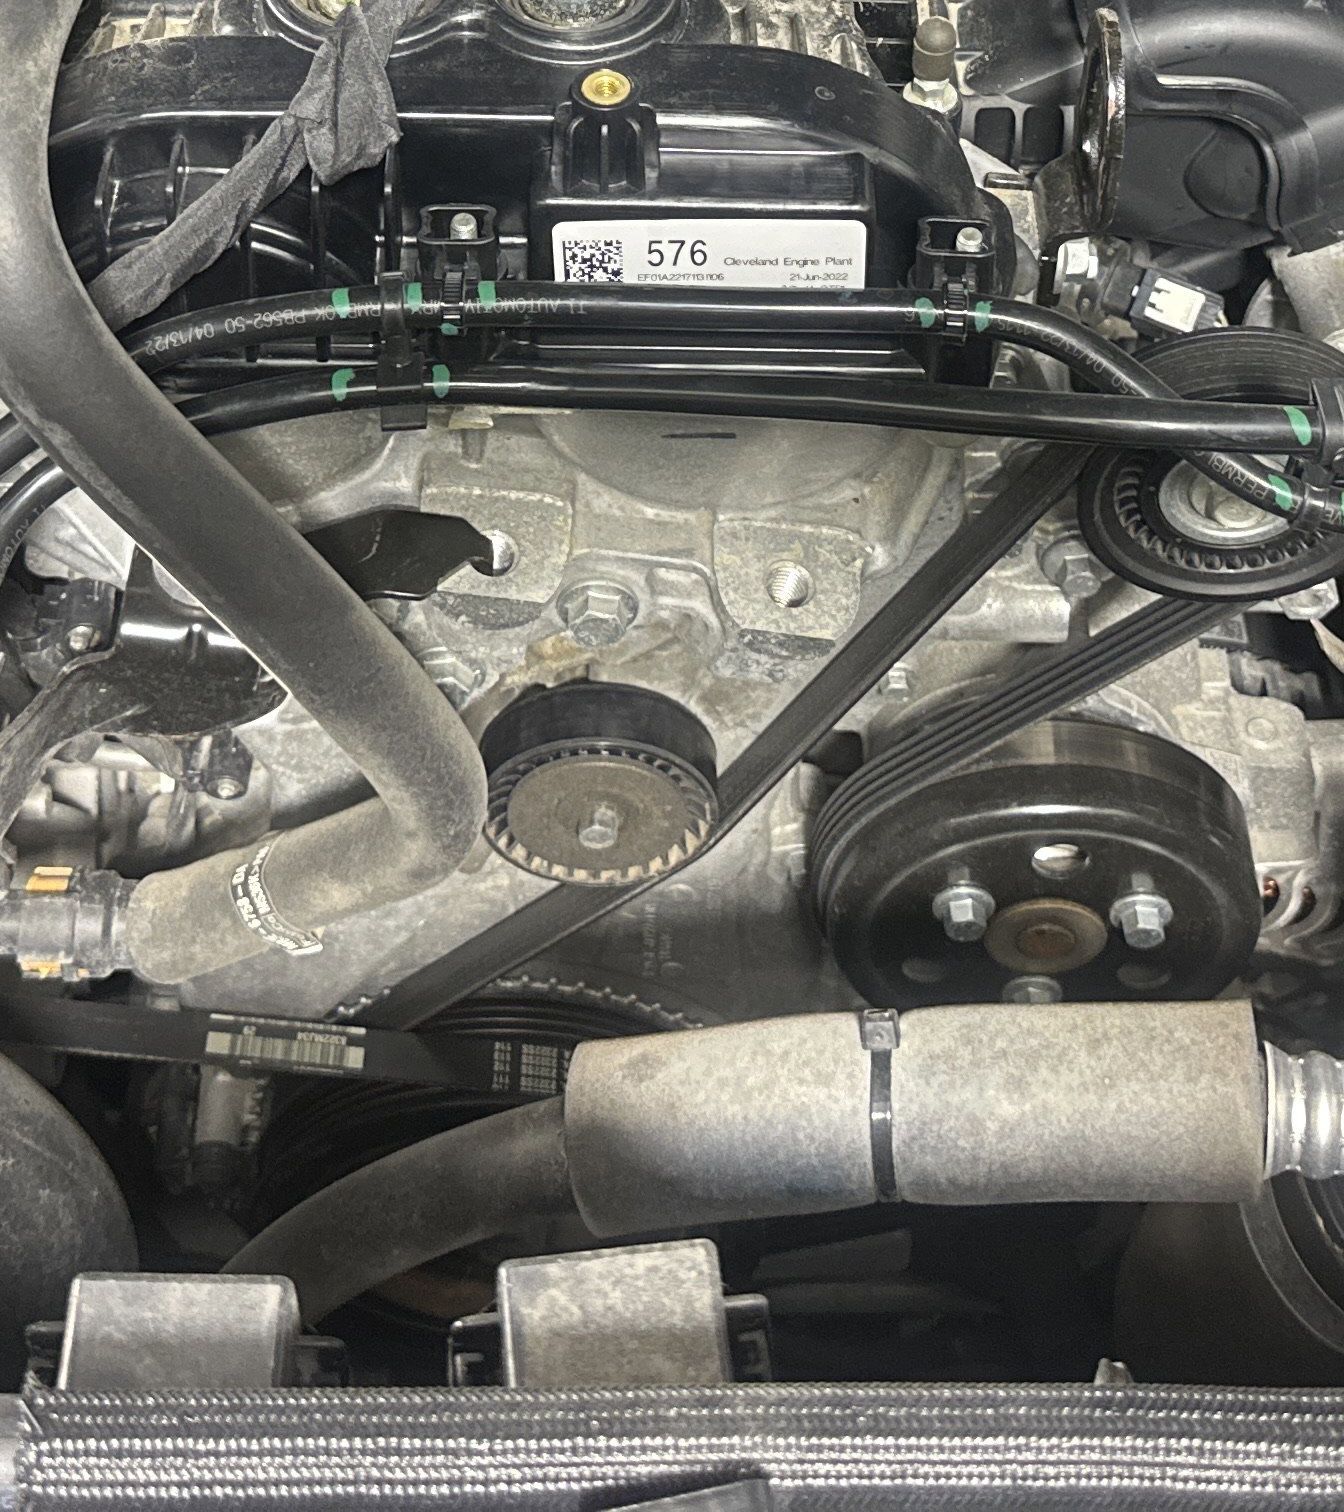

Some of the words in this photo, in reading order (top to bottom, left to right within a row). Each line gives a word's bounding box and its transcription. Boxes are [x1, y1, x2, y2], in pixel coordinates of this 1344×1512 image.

[646, 239, 709, 267] 576
[723, 256, 779, 267] Cleveland
[783, 257, 820, 269] Engine
[824, 256, 854, 267] Plant
[788, 272, 849, 281] 21-Jun-2022
[464, 296, 560, 315] AUTOMOTIV
[224, 307, 306, 334] PB562-50
[144, 321, 216, 354] 04/13/22
[1193, 451, 1269, 499] PERMBL
